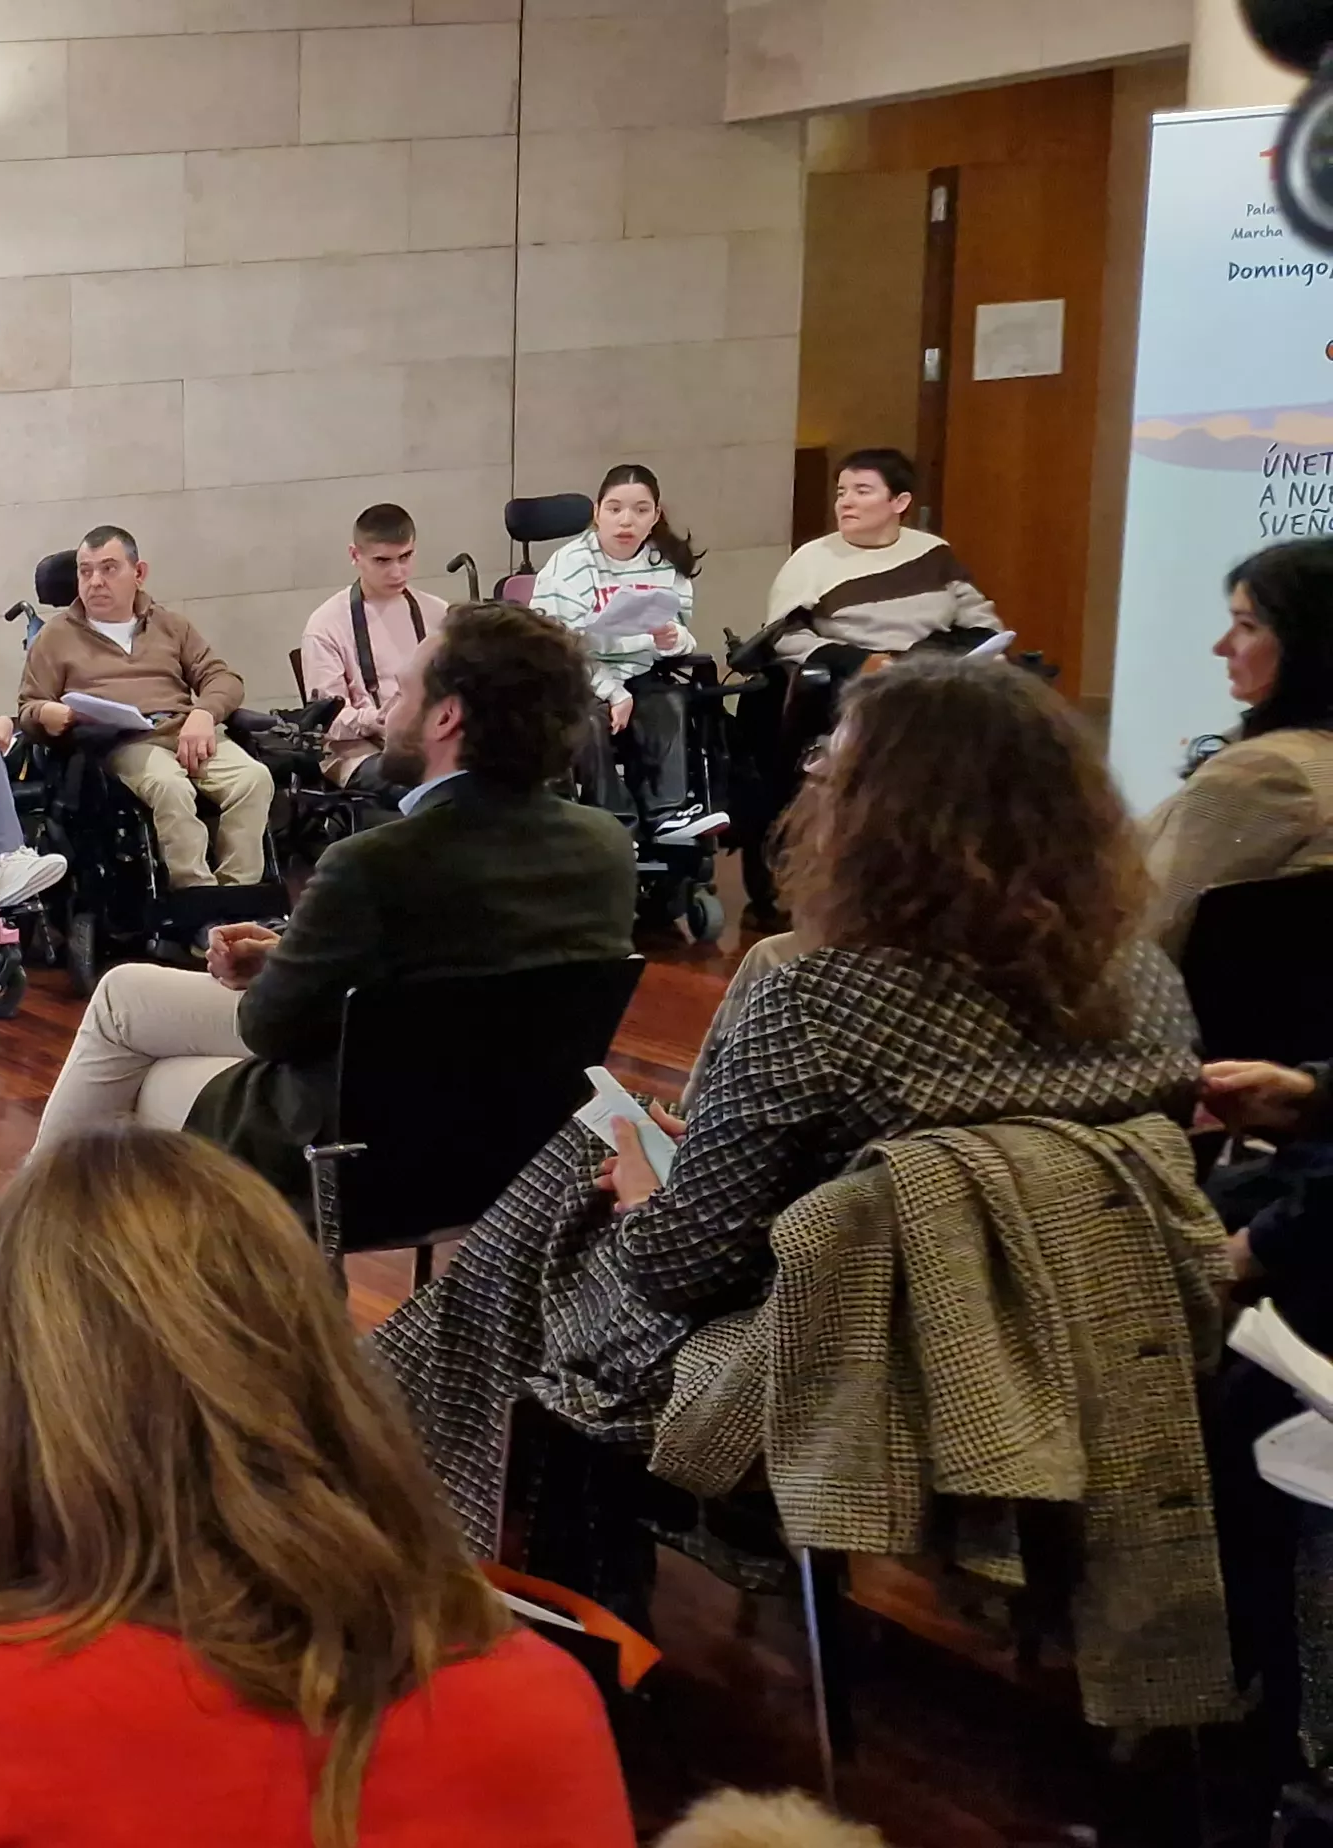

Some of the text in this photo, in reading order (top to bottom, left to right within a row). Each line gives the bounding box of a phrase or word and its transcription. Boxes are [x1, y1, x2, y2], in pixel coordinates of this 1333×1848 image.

[1246, 203, 1280, 217] Pala
[1231, 225, 1283, 240] Marcha
[1259, 483, 1276, 508] A
